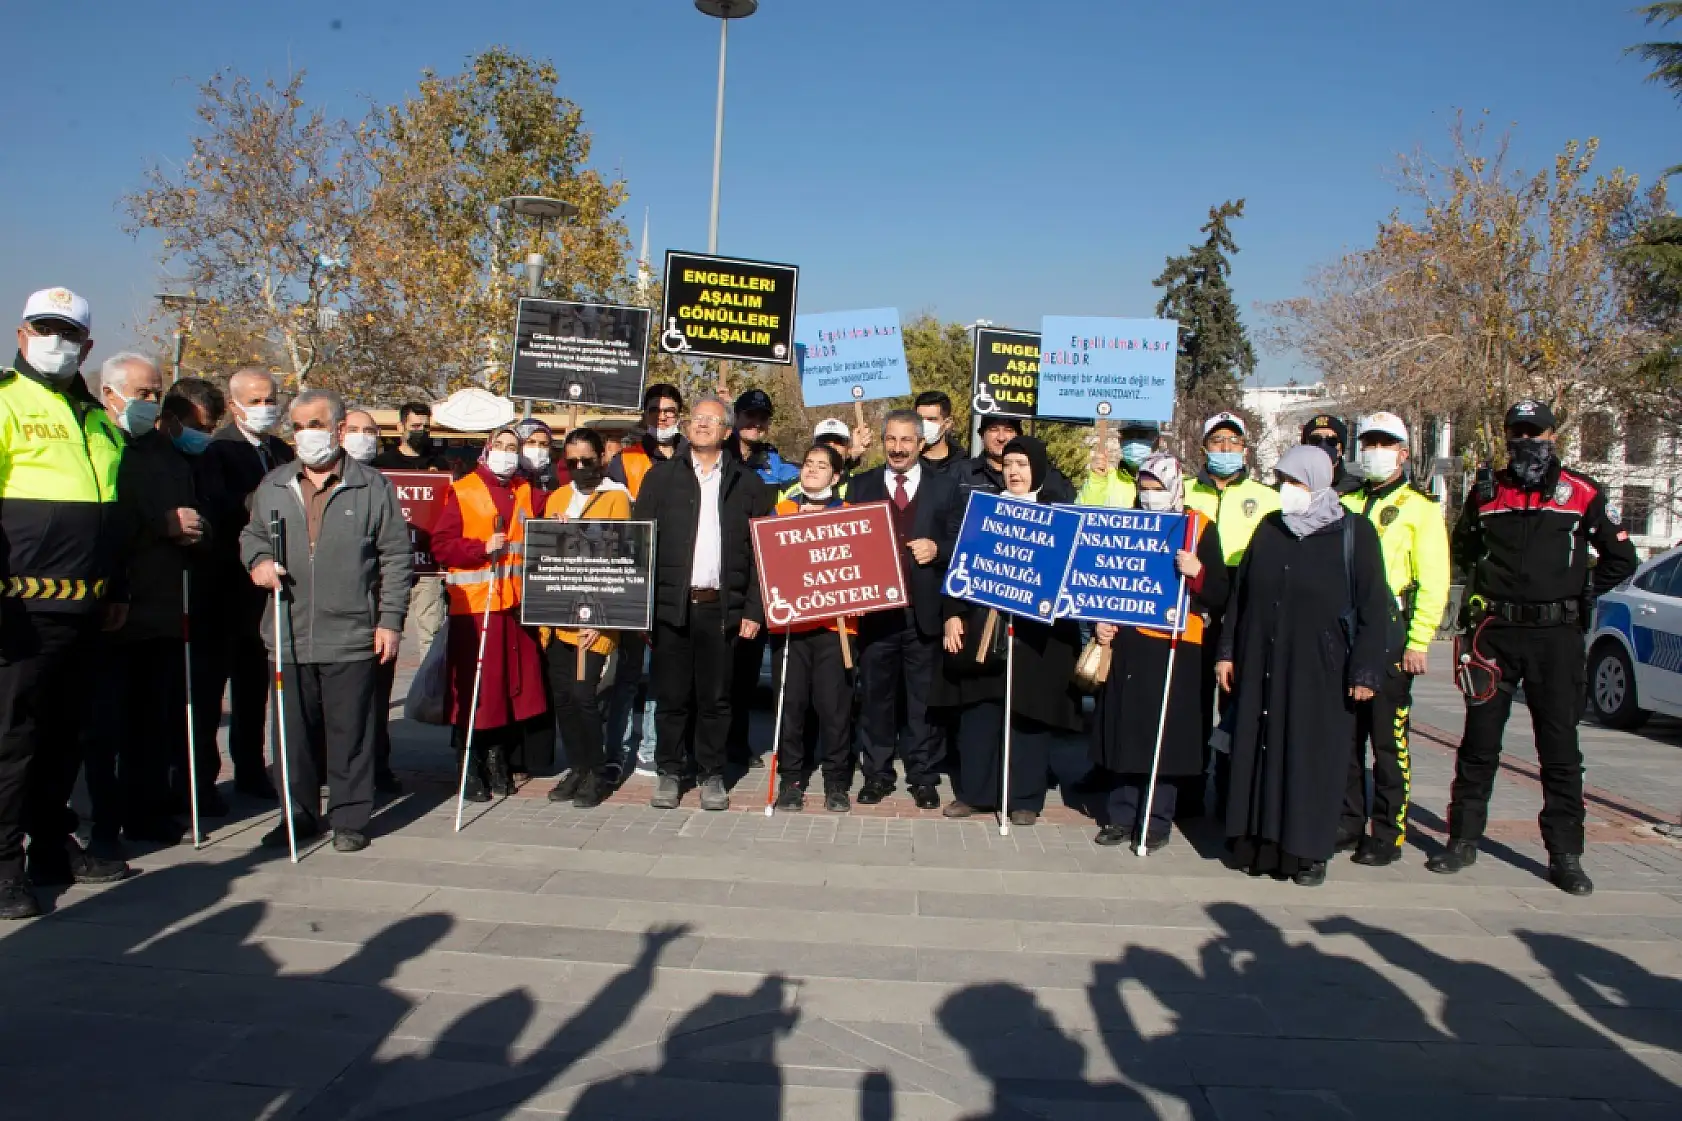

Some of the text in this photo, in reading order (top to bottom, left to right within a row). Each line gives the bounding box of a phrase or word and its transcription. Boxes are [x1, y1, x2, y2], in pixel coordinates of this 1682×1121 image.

[699, 289, 763, 309] AŞALIM
[679, 305, 779, 329] GÖNÜLLERE
[686, 324, 771, 346] ULAŞALIM
[1070, 335, 1171, 352] Engelli olmak kusur
[804, 344, 838, 359] EĞİLDİR
[1043, 371, 1166, 388] Herhangi bir Aralıkta değil her
[1058, 388, 1085, 397] zaman
[994, 501, 1054, 527] ENGELLİ
[1087, 513, 1162, 532] ENGELLİ
[981, 516, 1056, 548] İNSANLARA
[993, 542, 1035, 563] SAYGI
[972, 554, 1042, 586] İNSANLIĞA
[1095, 554, 1147, 573] SAYGI
[802, 565, 862, 587] SAYGI
[1071, 570, 1163, 595] İNSANLIĞA
[795, 585, 881, 611] GÖSTER!
[970, 576, 1034, 605] SAYGIDIR
[1075, 594, 1157, 615] SAYGIDIR
